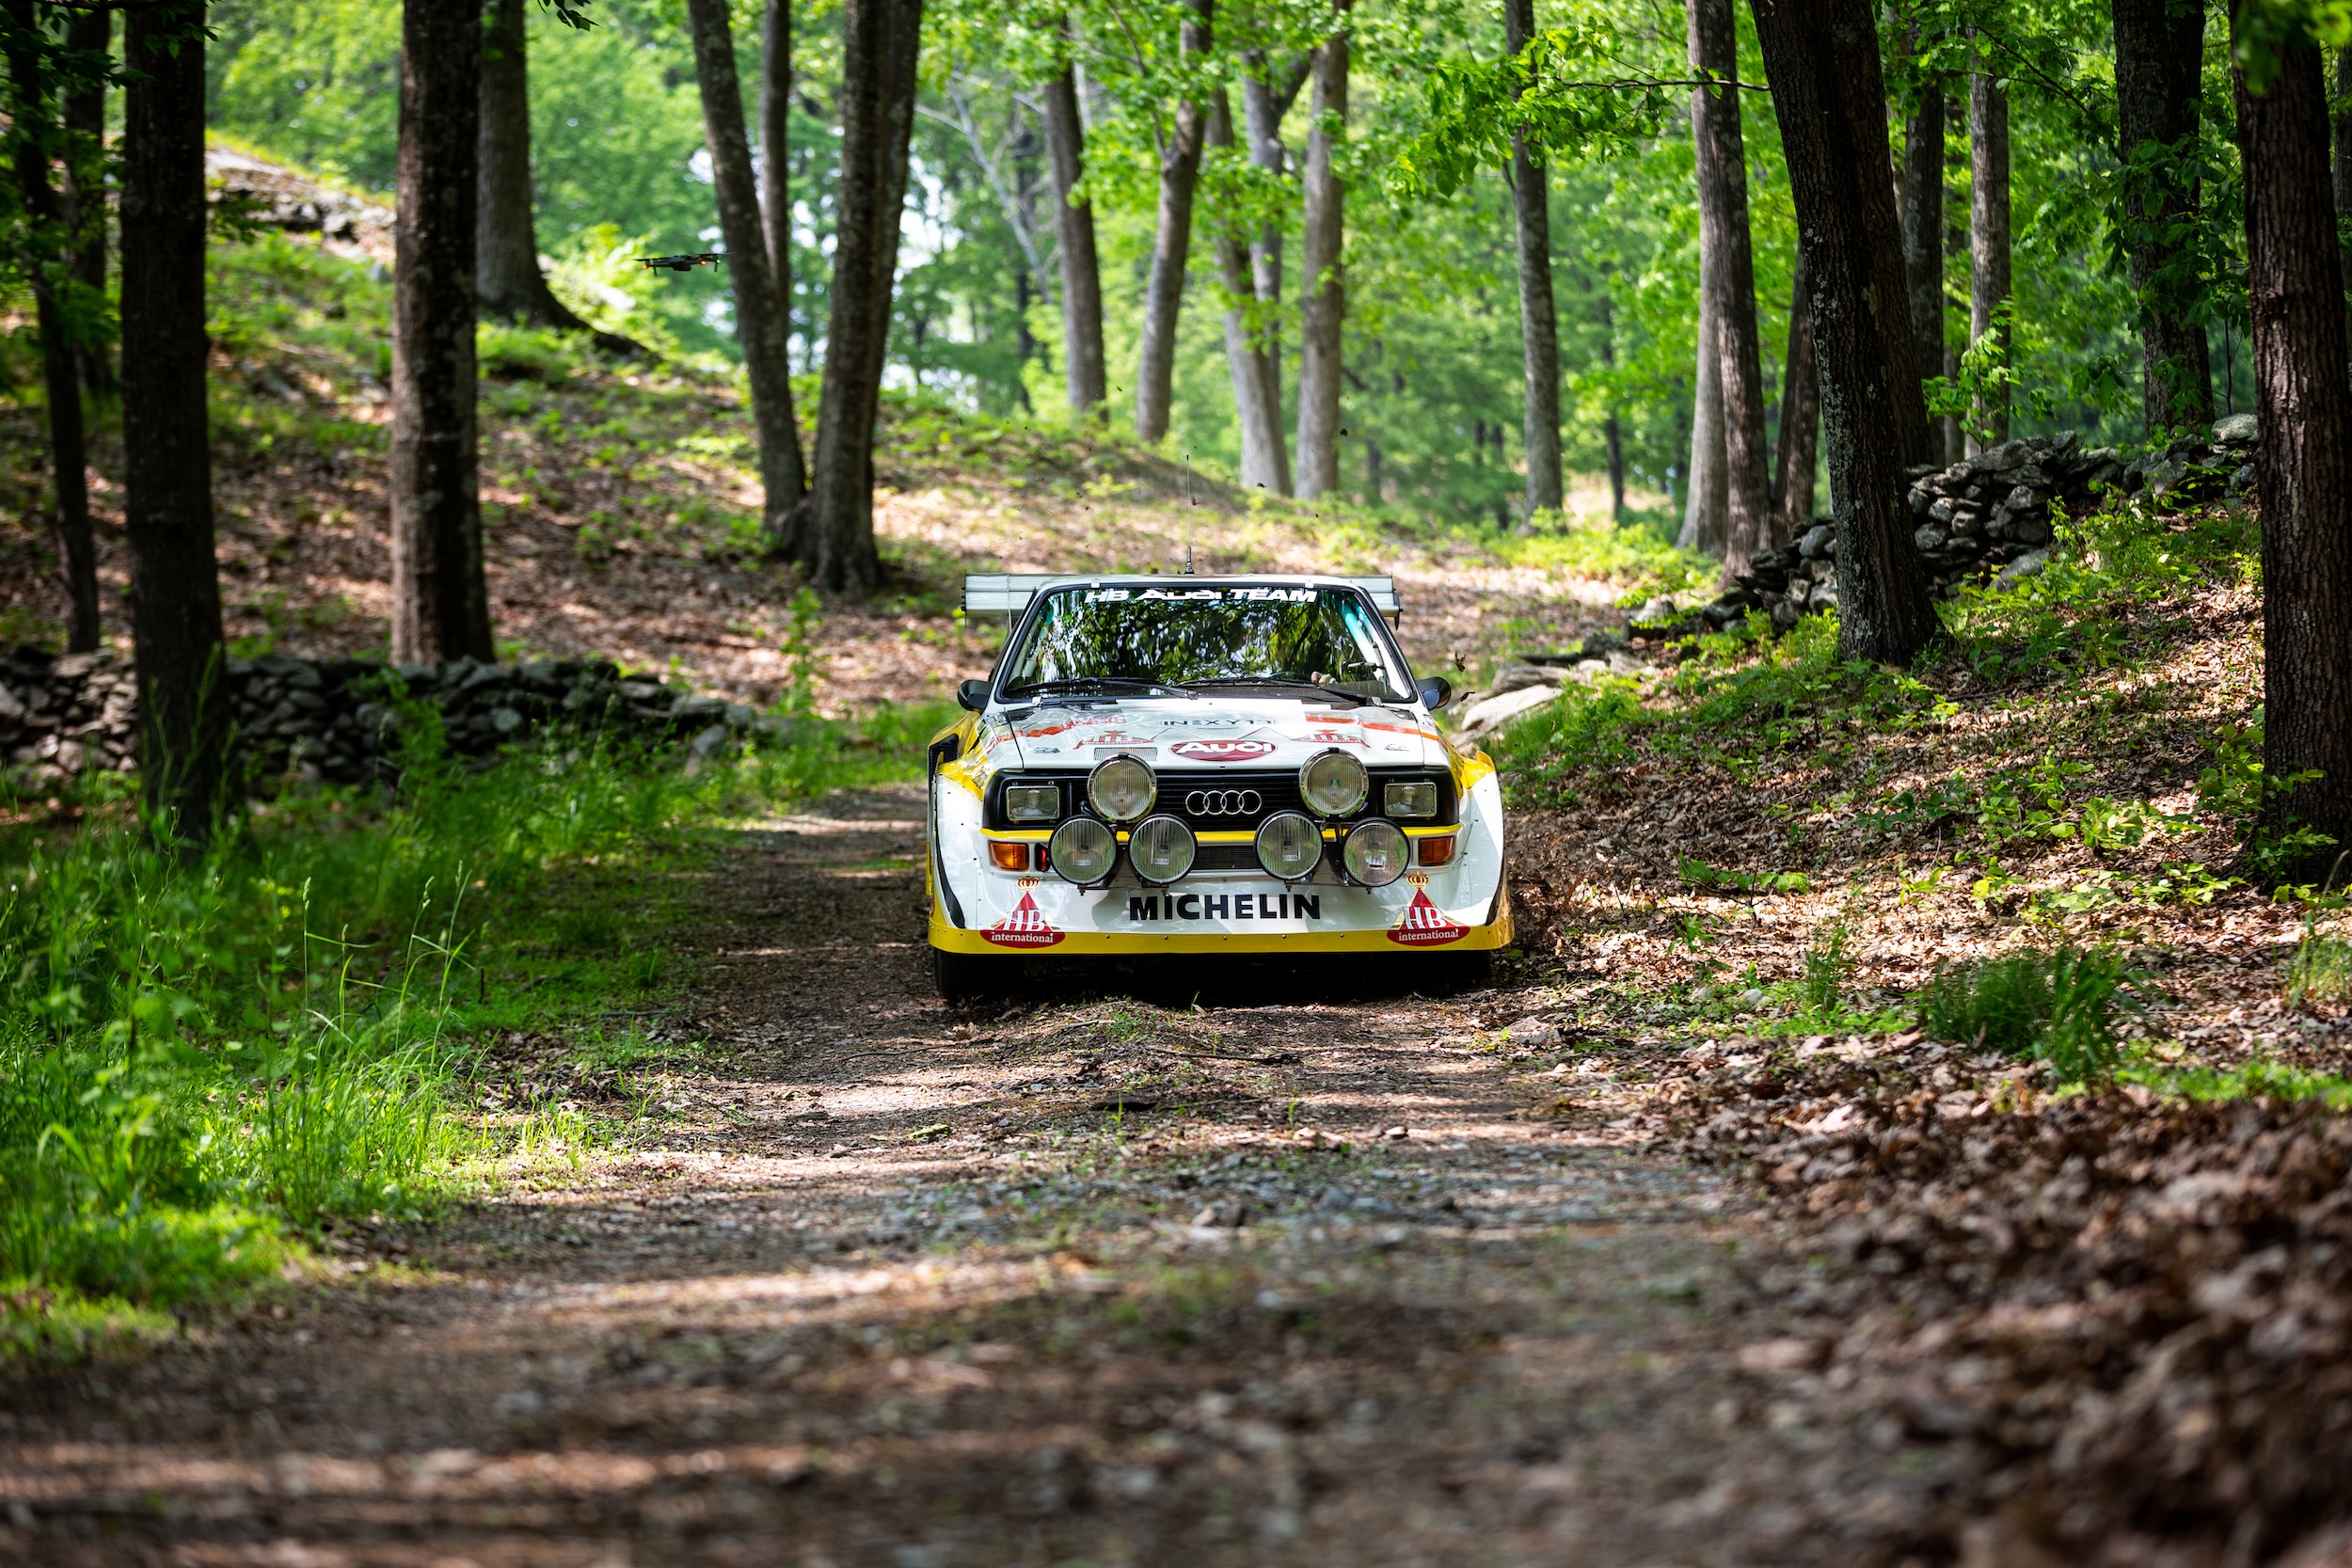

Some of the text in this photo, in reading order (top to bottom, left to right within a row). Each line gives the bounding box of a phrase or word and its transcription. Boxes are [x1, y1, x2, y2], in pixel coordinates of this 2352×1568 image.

[1085, 588, 1317, 603] HB Audi TEAM
[1176, 741, 1273, 753] Audi
[1129, 894, 1321, 920] MICHELIN
[1002, 909, 1045, 931] HB
[1402, 907, 1447, 930] HB
[991, 931, 1053, 942] international
[1398, 928, 1459, 942] international
